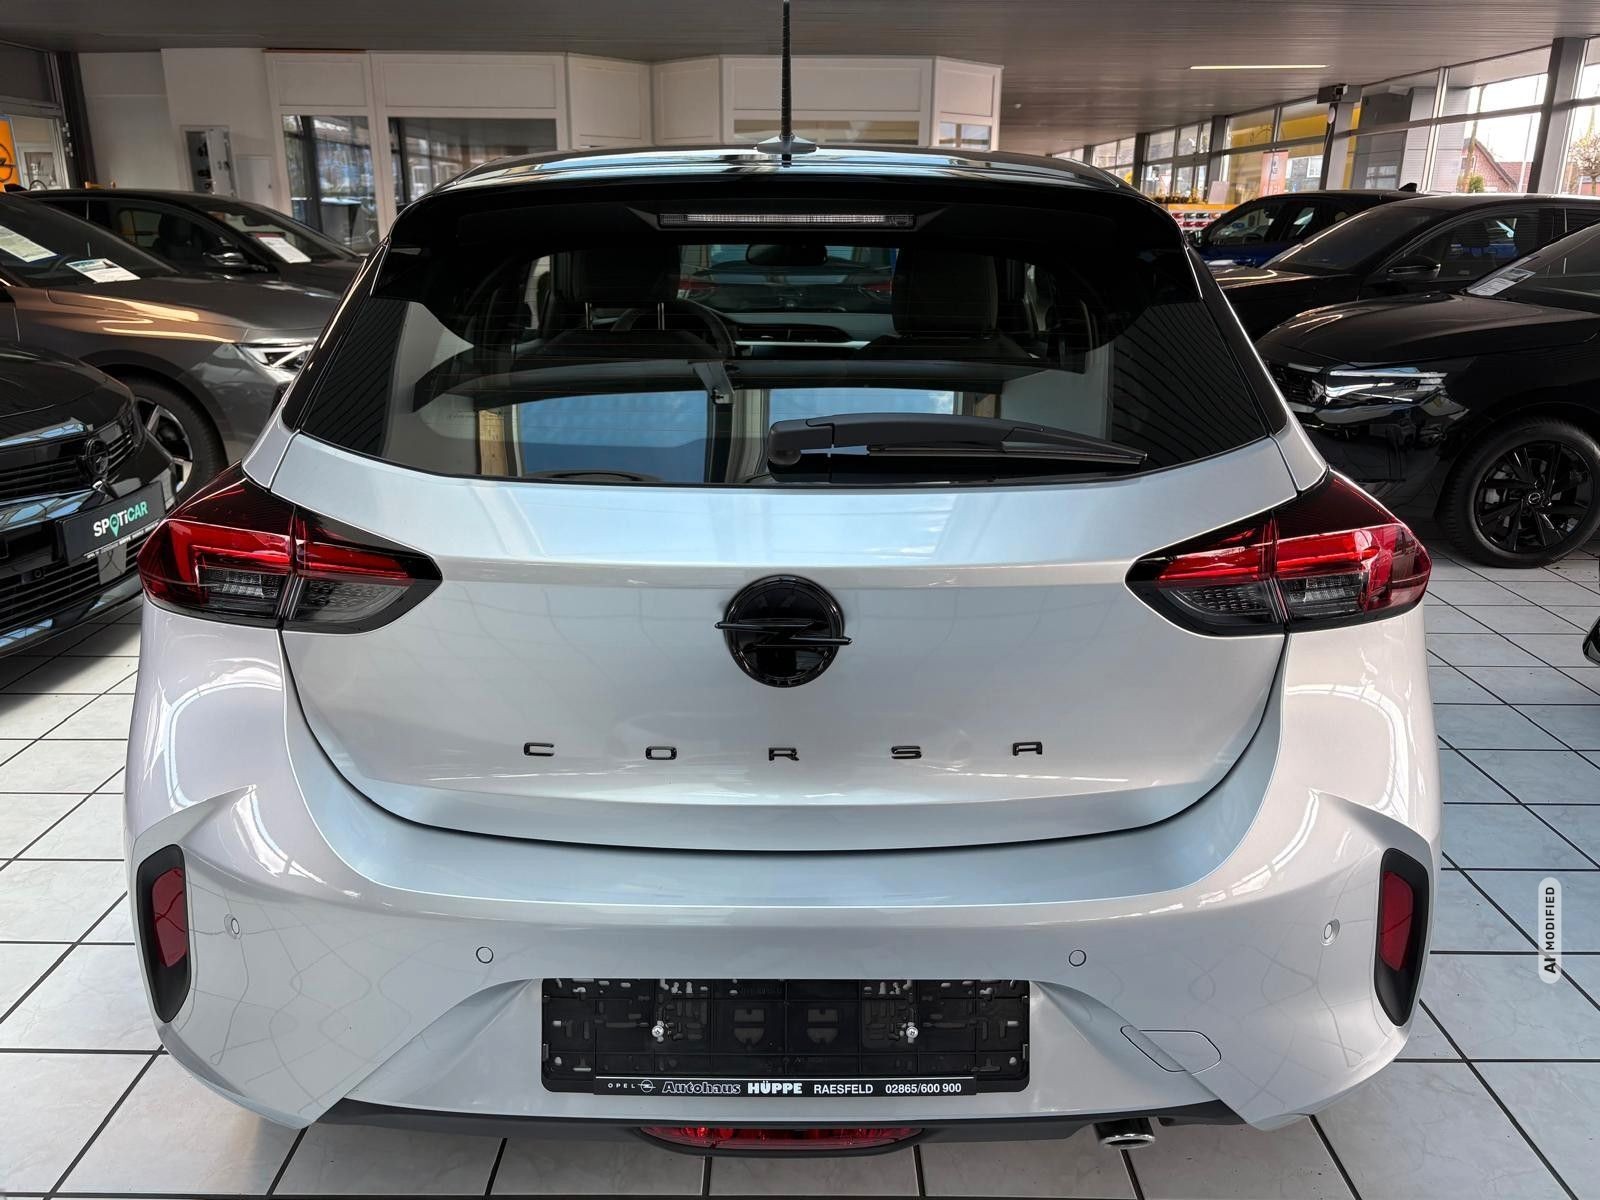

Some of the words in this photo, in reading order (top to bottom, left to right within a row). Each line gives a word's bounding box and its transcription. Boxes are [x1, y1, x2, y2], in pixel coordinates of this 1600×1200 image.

[523, 741, 1043, 761] CORSA
[661, 1081, 741, 1094] Autohaus
[747, 1080, 803, 1094] HÜPPE
[813, 1084, 873, 1094] RAESFELD
[885, 1083, 940, 1094] 02865/600
[942, 1083, 962, 1093] 900
